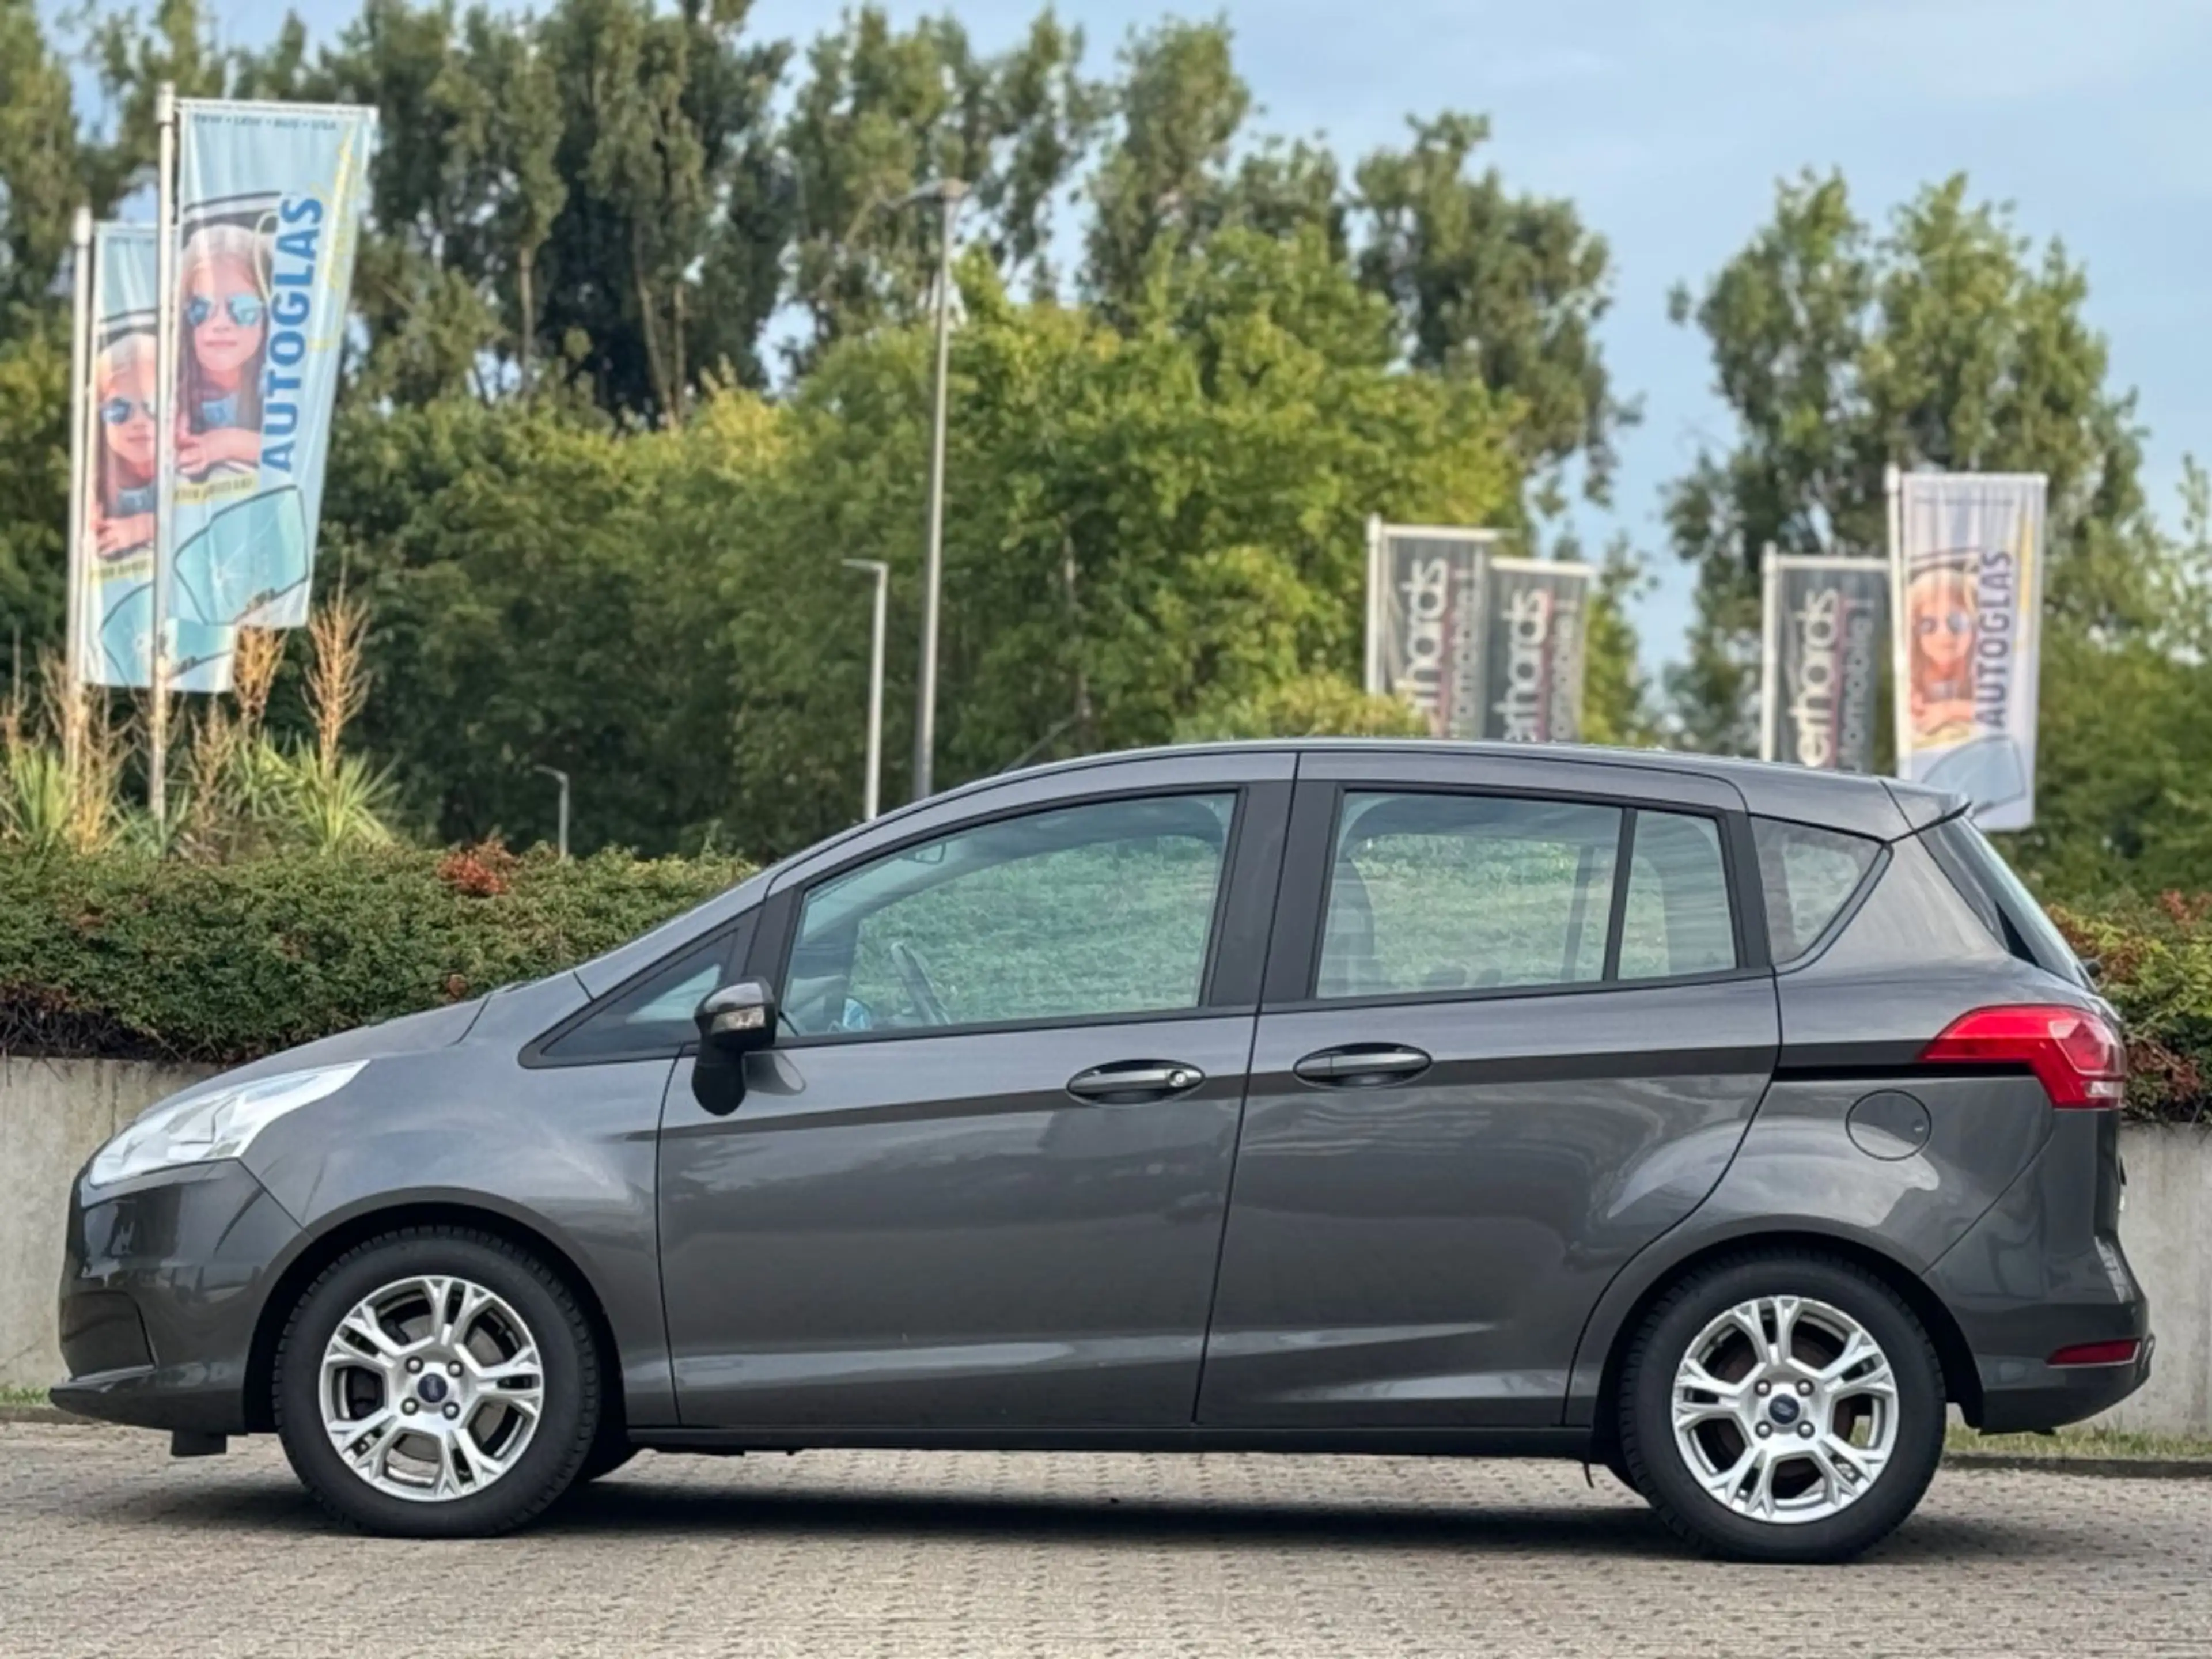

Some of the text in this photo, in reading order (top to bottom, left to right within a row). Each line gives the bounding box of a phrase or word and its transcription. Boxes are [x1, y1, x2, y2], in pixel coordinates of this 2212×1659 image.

[261, 198, 323, 472] AUTOGLAS
[1395, 558, 1448, 712] rhards
[1975, 550, 2012, 729] AUTOGLAS
